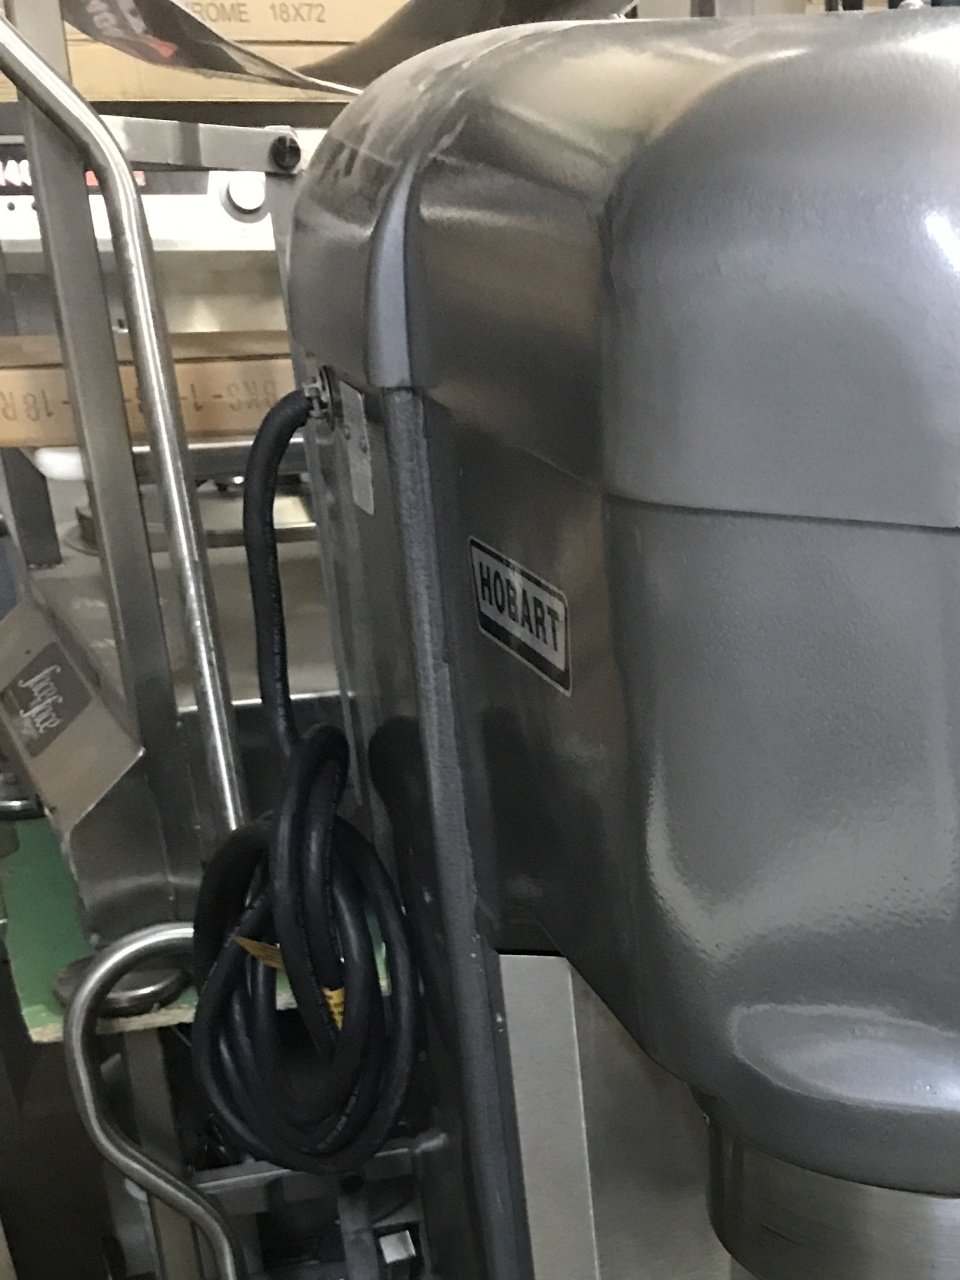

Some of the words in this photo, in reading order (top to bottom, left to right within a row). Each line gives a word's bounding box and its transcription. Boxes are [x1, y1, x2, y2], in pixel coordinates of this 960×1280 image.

[187, 2, 250, 23] ROME
[269, 2, 327, 23] 18X72
[479, 561, 560, 652] HOBART
